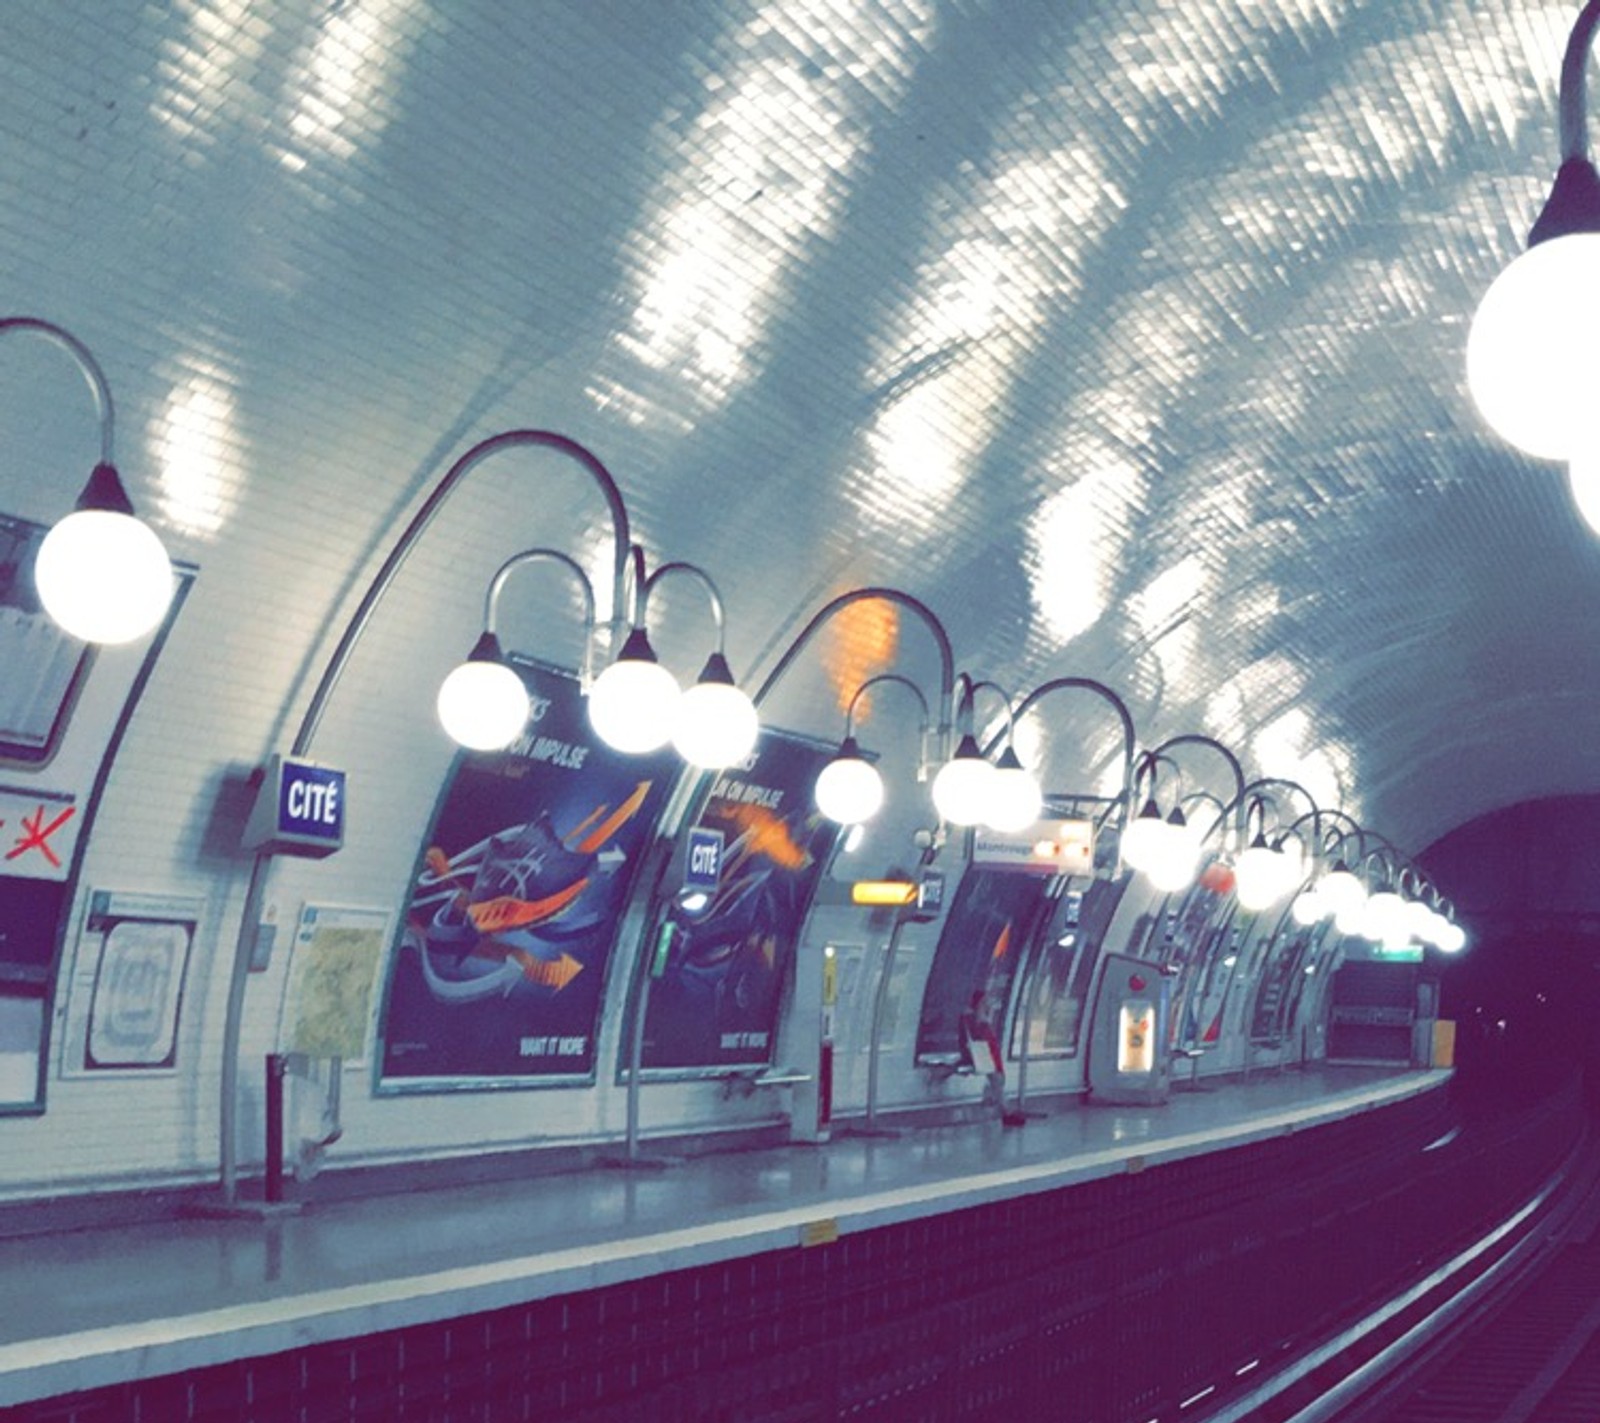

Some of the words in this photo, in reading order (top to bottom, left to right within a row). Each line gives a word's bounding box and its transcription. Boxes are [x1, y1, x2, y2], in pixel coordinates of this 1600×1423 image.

[529, 737, 589, 770] IMPULSE
[287, 779, 338, 825] CITÉ
[740, 784, 785, 810] IMPULSE
[690, 841, 719, 875] CITÉ
[520, 1036, 548, 1056] WANT
[547, 1036, 559, 1056] IT
[557, 1036, 587, 1056] MORE
